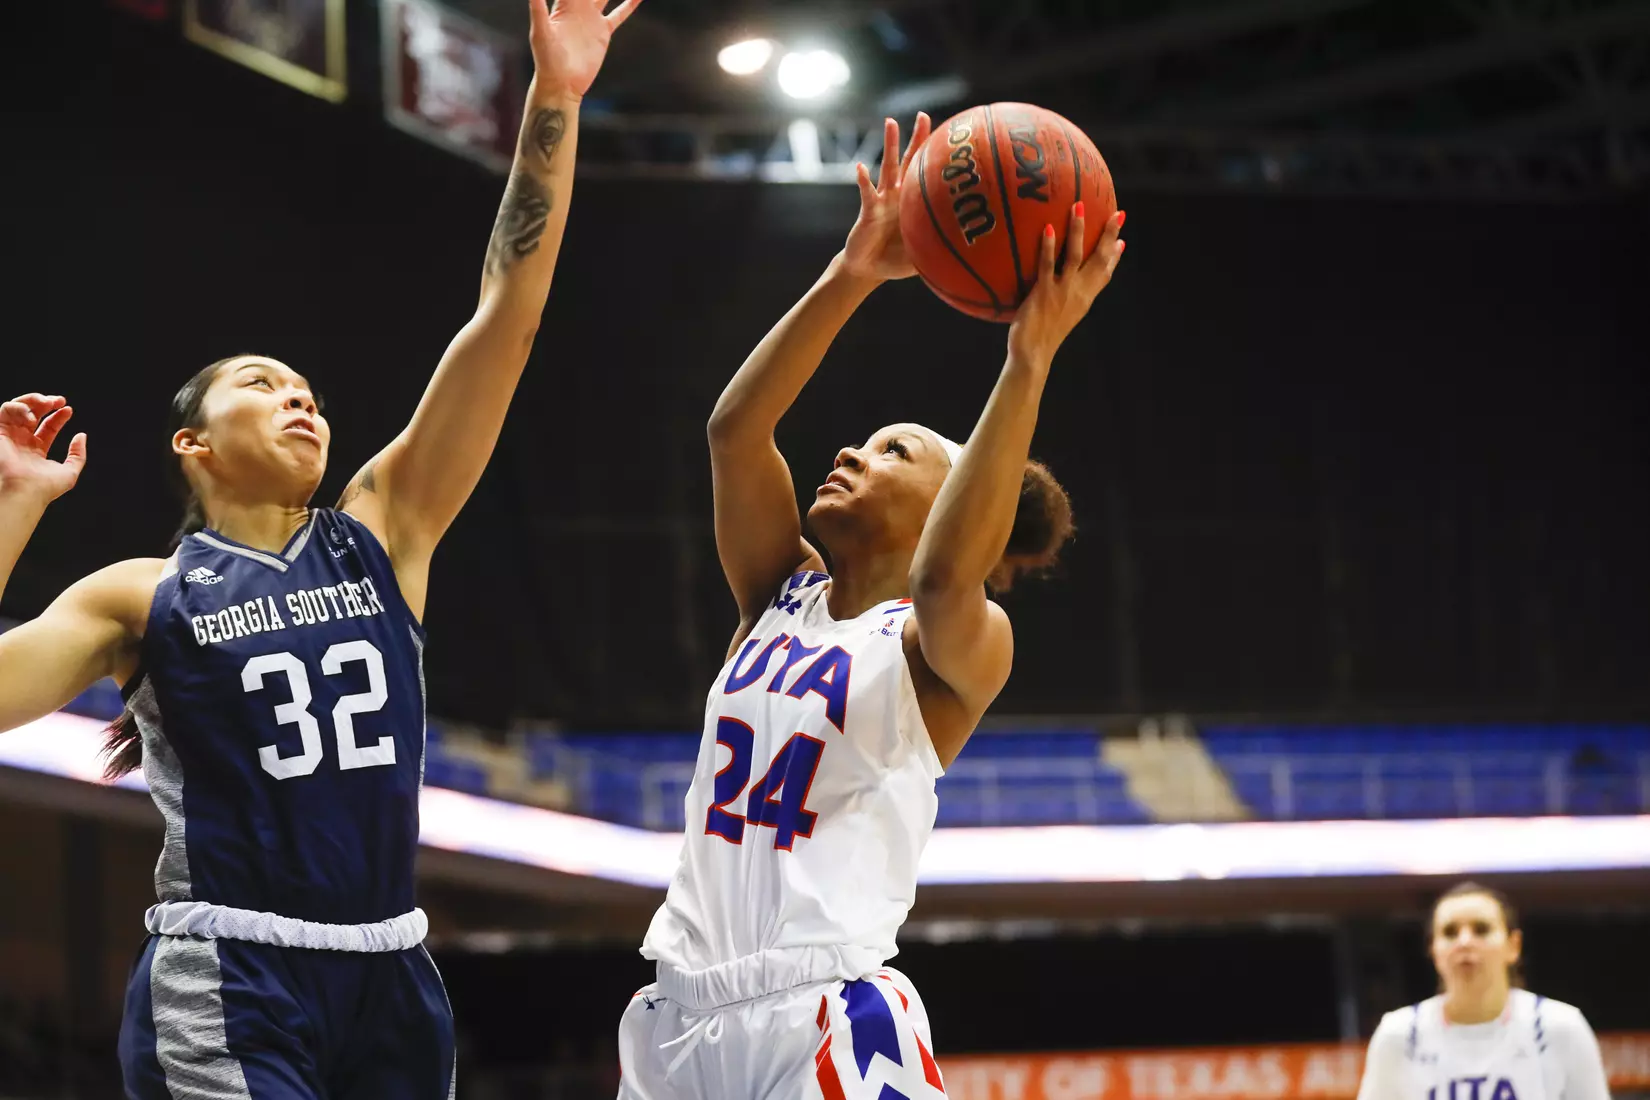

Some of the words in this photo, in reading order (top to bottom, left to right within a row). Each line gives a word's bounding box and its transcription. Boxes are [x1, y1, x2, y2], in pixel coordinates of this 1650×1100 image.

[185, 575, 224, 586] adidas
[191, 596, 287, 646] GEORGIA
[286, 575, 386, 628] SOUTHER
[240, 639, 397, 781] 32
[723, 631, 853, 735] UTA
[704, 715, 826, 853] 24
[1127, 1052, 1289, 1098] TEXAS
